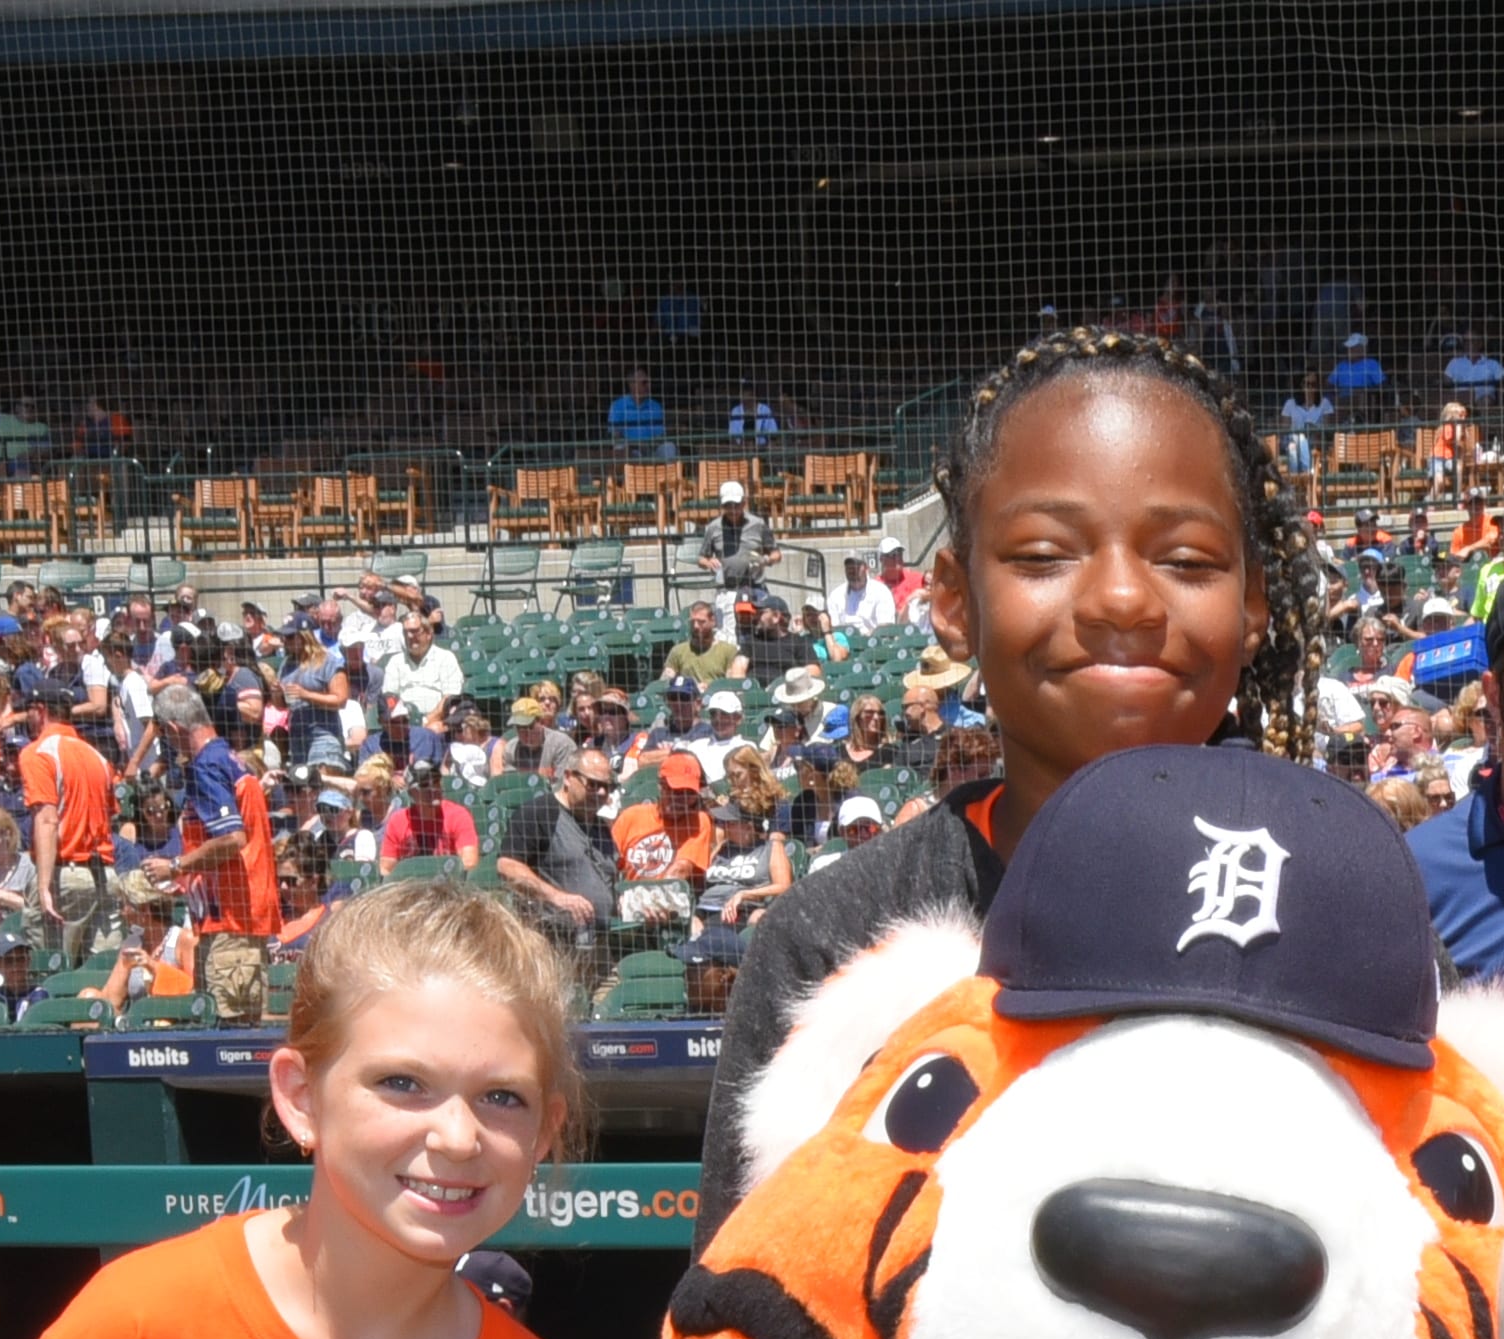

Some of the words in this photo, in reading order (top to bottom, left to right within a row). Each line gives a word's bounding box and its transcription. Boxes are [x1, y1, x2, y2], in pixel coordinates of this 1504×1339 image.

[1176, 815, 1292, 953] D
[128, 1048, 190, 1067] bitbits
[218, 1047, 274, 1064] tigers.co
[591, 1041, 655, 1058] tigers.com
[164, 1194, 226, 1215] PURE
[525, 1185, 700, 1227] tigers.co
